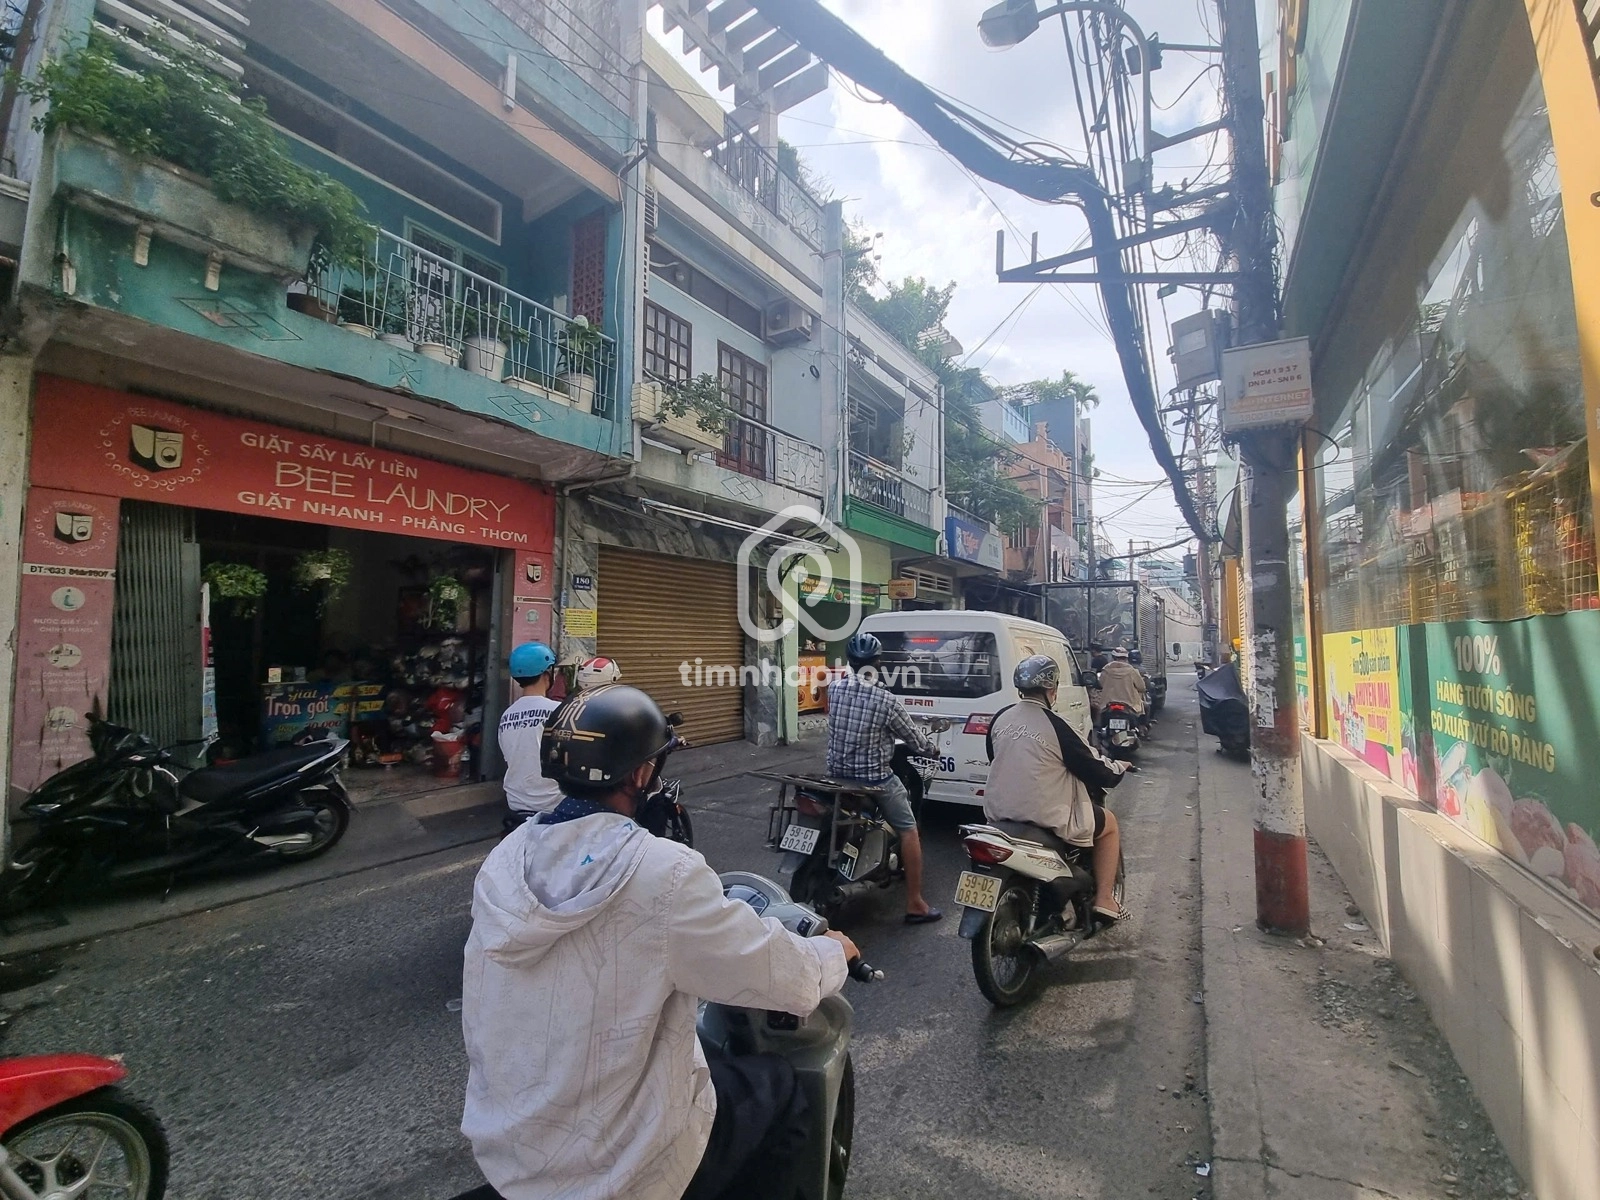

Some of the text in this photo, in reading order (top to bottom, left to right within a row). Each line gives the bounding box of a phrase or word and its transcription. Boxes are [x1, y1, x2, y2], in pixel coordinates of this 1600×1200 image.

[240, 432, 418, 480] GIẶT SẤY LẤY LIỀN
[275, 461, 511, 523] BEE LAUNDRY
[237, 491, 297, 511] GIẶT
[302, 500, 384, 523] NHANH
[479, 526, 528, 544] THƠM
[1454, 634, 1500, 676] 100%
[264, 696, 302, 719] Trọn
[307, 695, 330, 719] gói
[521, 709, 550, 719] WOUN
[904, 698, 934, 707] SRM
[1436, 676, 1536, 723] HÀNG TƯƠI SỐNG
[1430, 706, 1555, 773] CÓ XUẤT XỨ RÕ RÀNG
[782, 837, 813, 853] 302.60
[789, 827, 814, 840] 59-G1
[959, 888, 994, 908] 083.23
